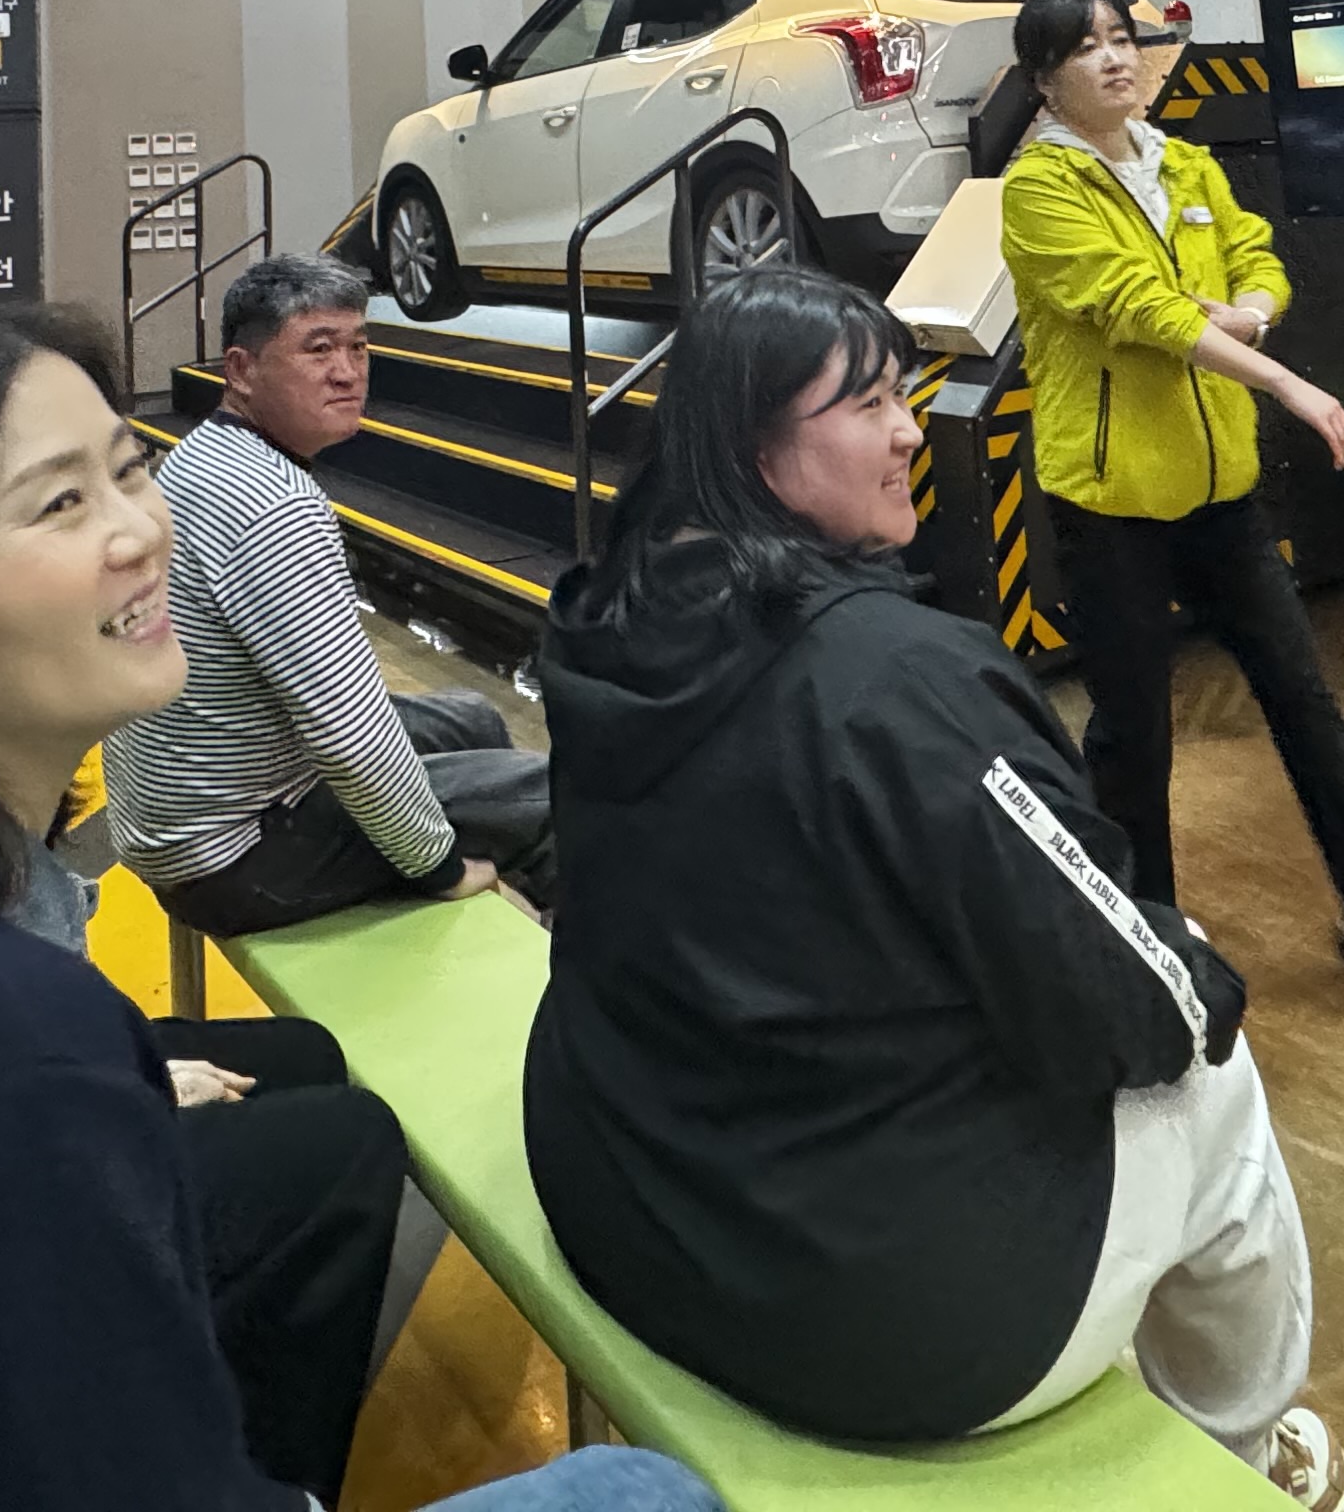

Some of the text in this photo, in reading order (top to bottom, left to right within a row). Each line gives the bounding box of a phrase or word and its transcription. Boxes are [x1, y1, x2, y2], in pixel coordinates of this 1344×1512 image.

[999, 777, 1037, 823] LABEL
[1048, 831, 1120, 915] BLACK LABEL
